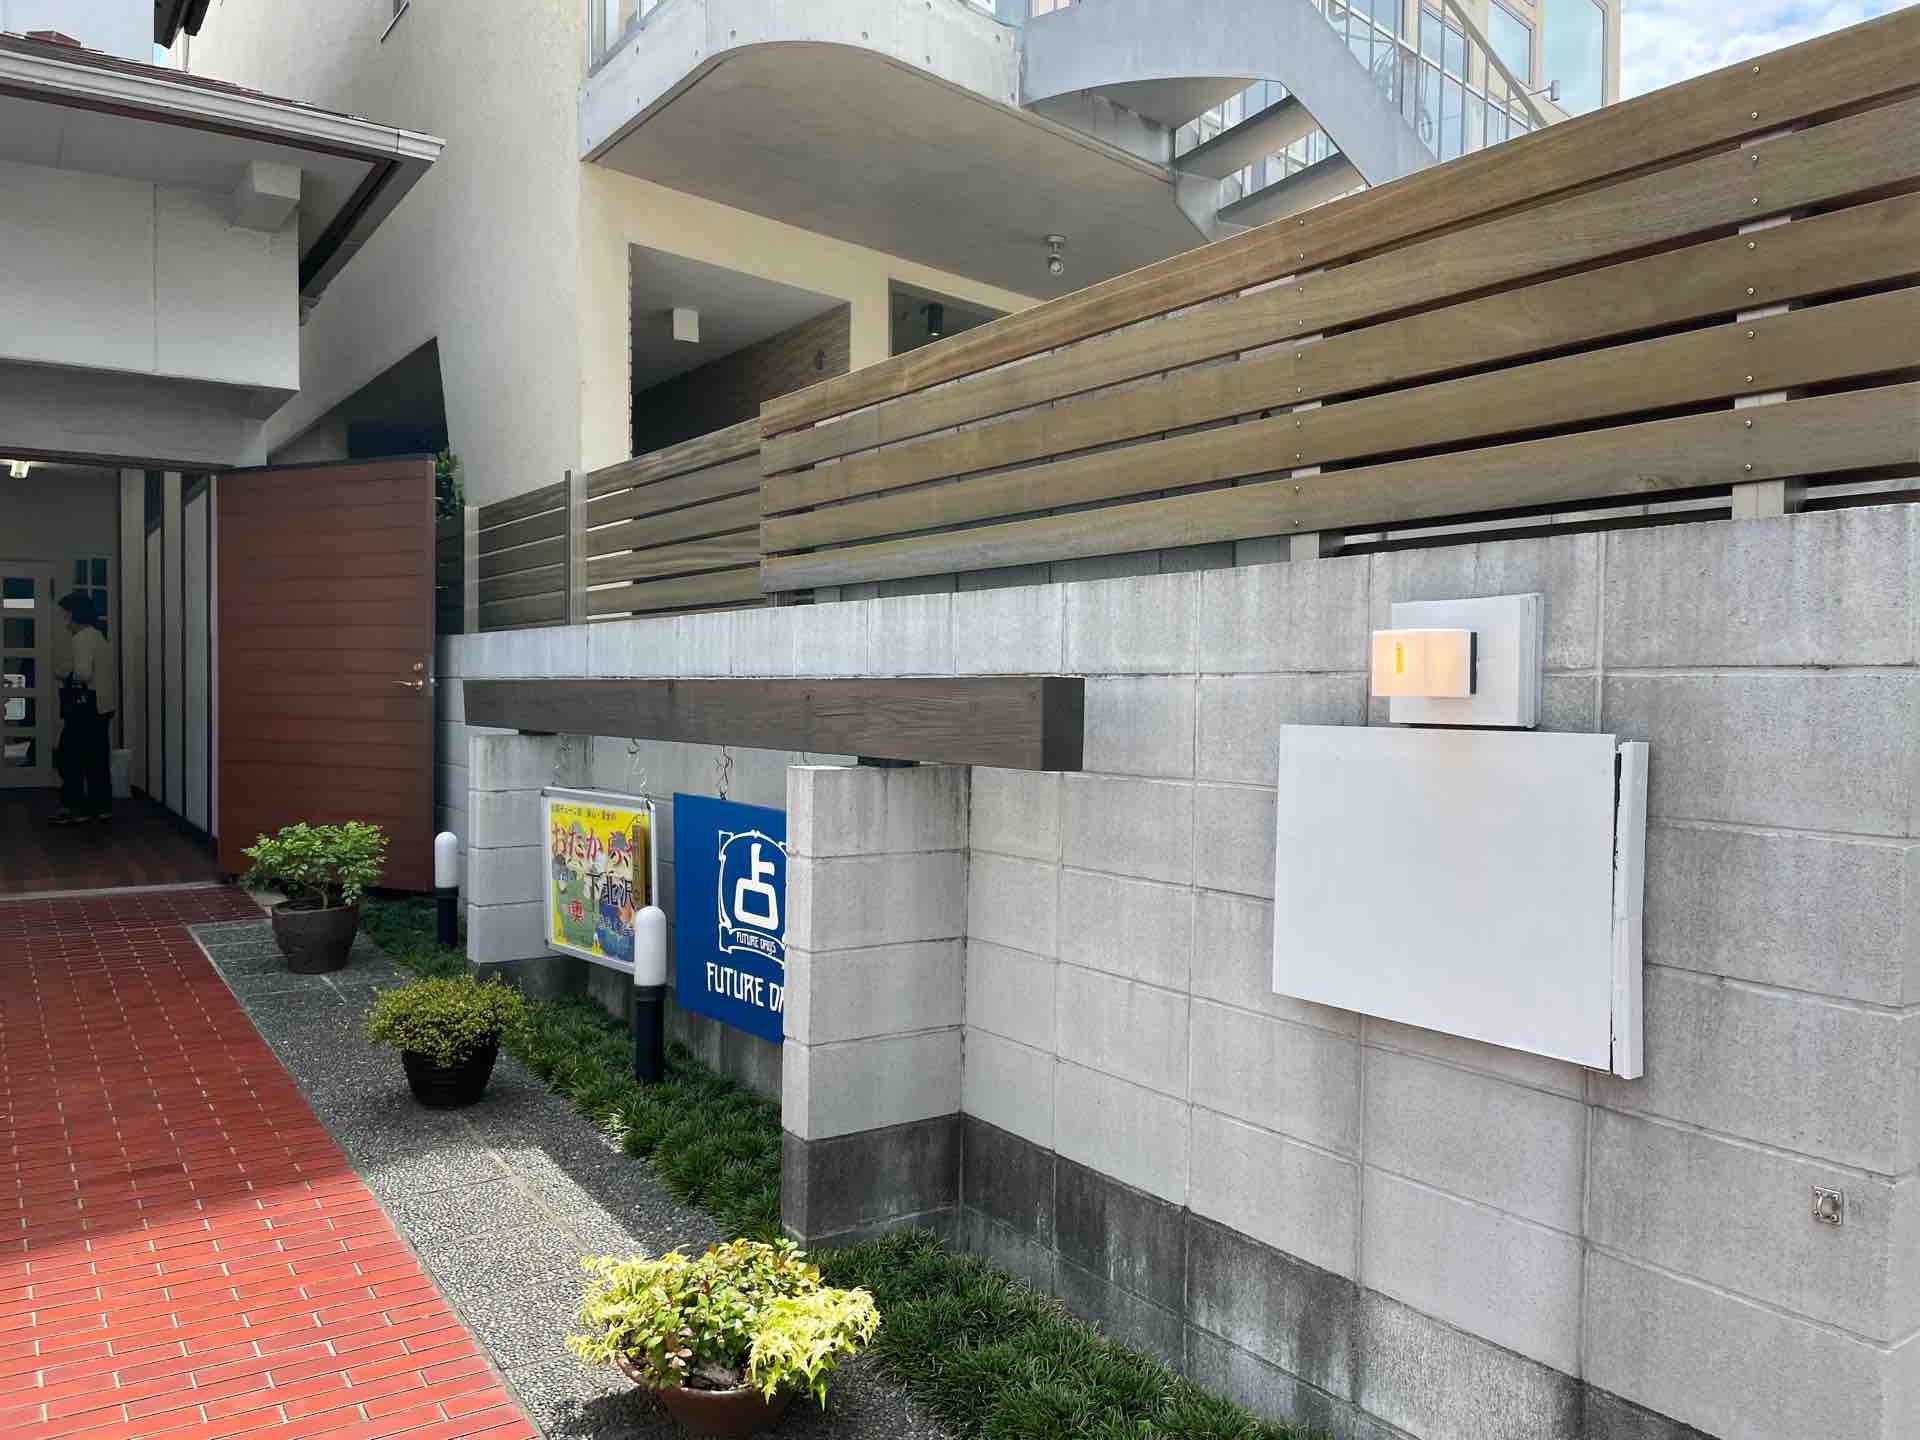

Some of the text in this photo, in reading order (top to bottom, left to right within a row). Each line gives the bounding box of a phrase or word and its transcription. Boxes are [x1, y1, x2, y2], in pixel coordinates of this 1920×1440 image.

[735, 843, 779, 930] 占
[736, 931, 759, 948] FUTURE
[706, 961, 765, 1007] FUTURE
